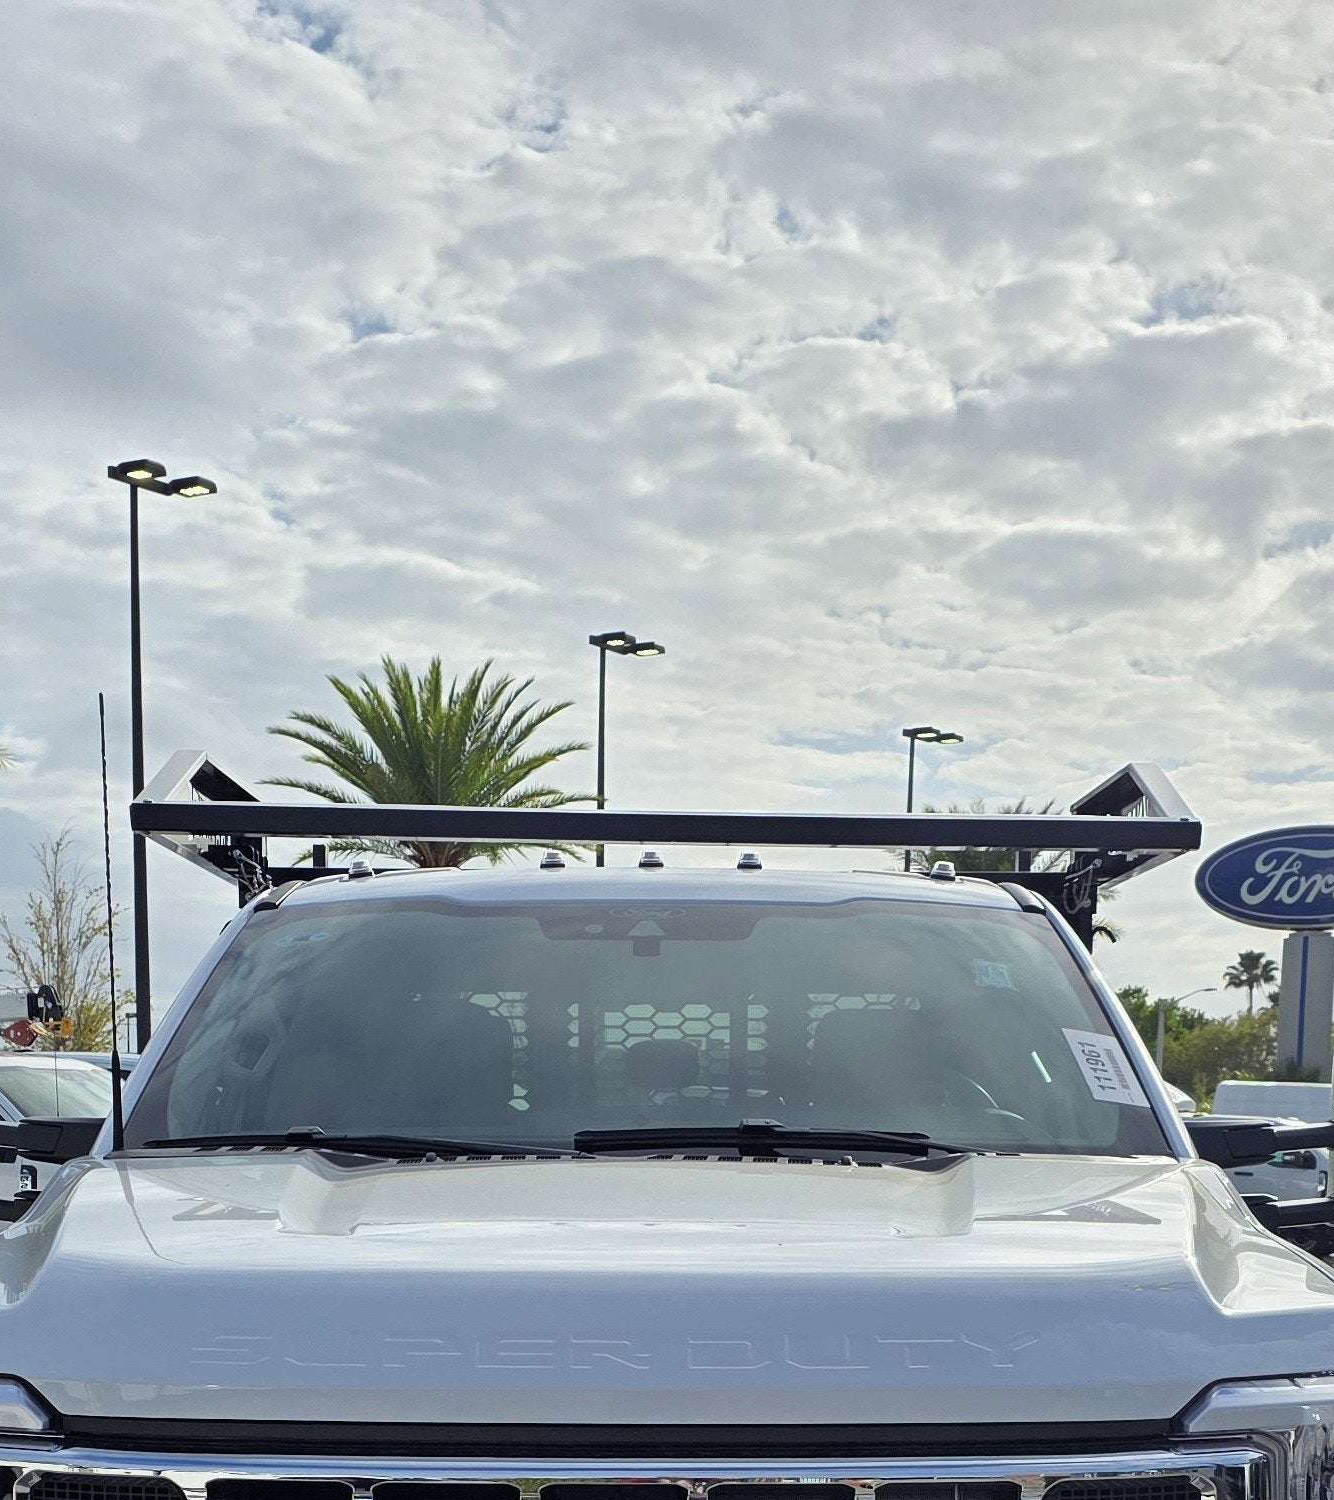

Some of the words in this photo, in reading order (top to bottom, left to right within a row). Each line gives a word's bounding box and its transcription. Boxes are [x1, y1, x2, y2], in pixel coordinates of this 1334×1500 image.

[1077, 1041, 1117, 1091] 111961
[189, 1332, 651, 1370] SUPER
[687, 1333, 1041, 1370] DUTY
